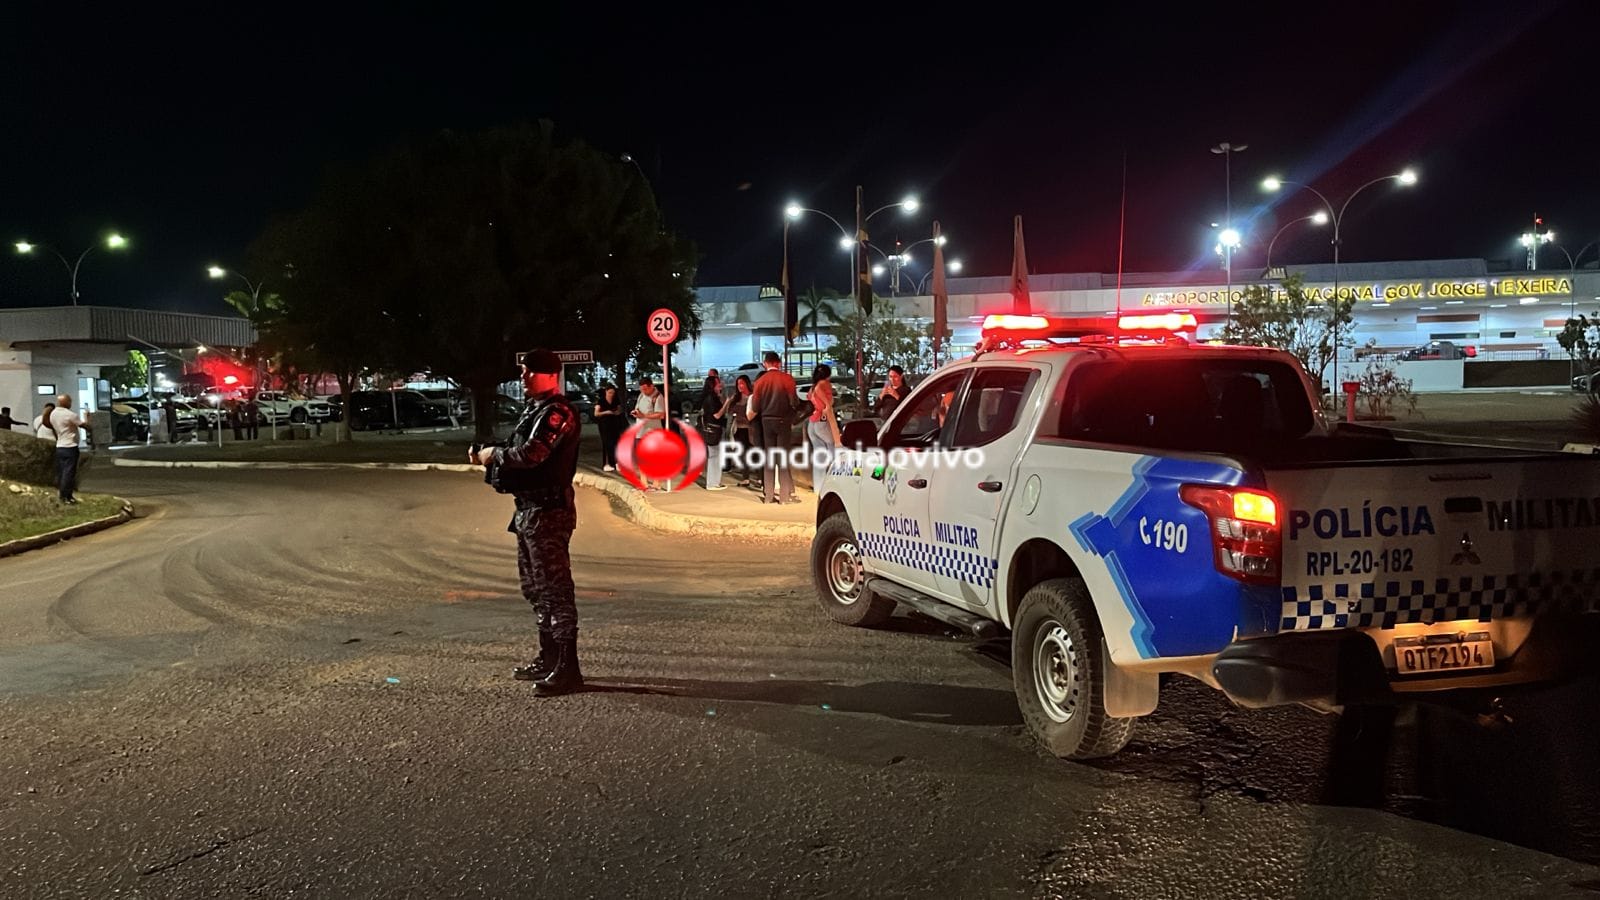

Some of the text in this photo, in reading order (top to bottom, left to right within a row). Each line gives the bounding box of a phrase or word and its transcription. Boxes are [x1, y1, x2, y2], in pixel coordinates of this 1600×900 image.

[1143, 290, 1242, 305] AEROPORTO
[1427, 281, 1486, 298] JORGE
[653, 316, 674, 331] 20
[883, 513, 979, 550] POLÍCIA MILITAR
[1289, 500, 1435, 541] POLÍCIA
[1153, 519, 1188, 554] 190
[1307, 548, 1414, 576] RPL-20-182
